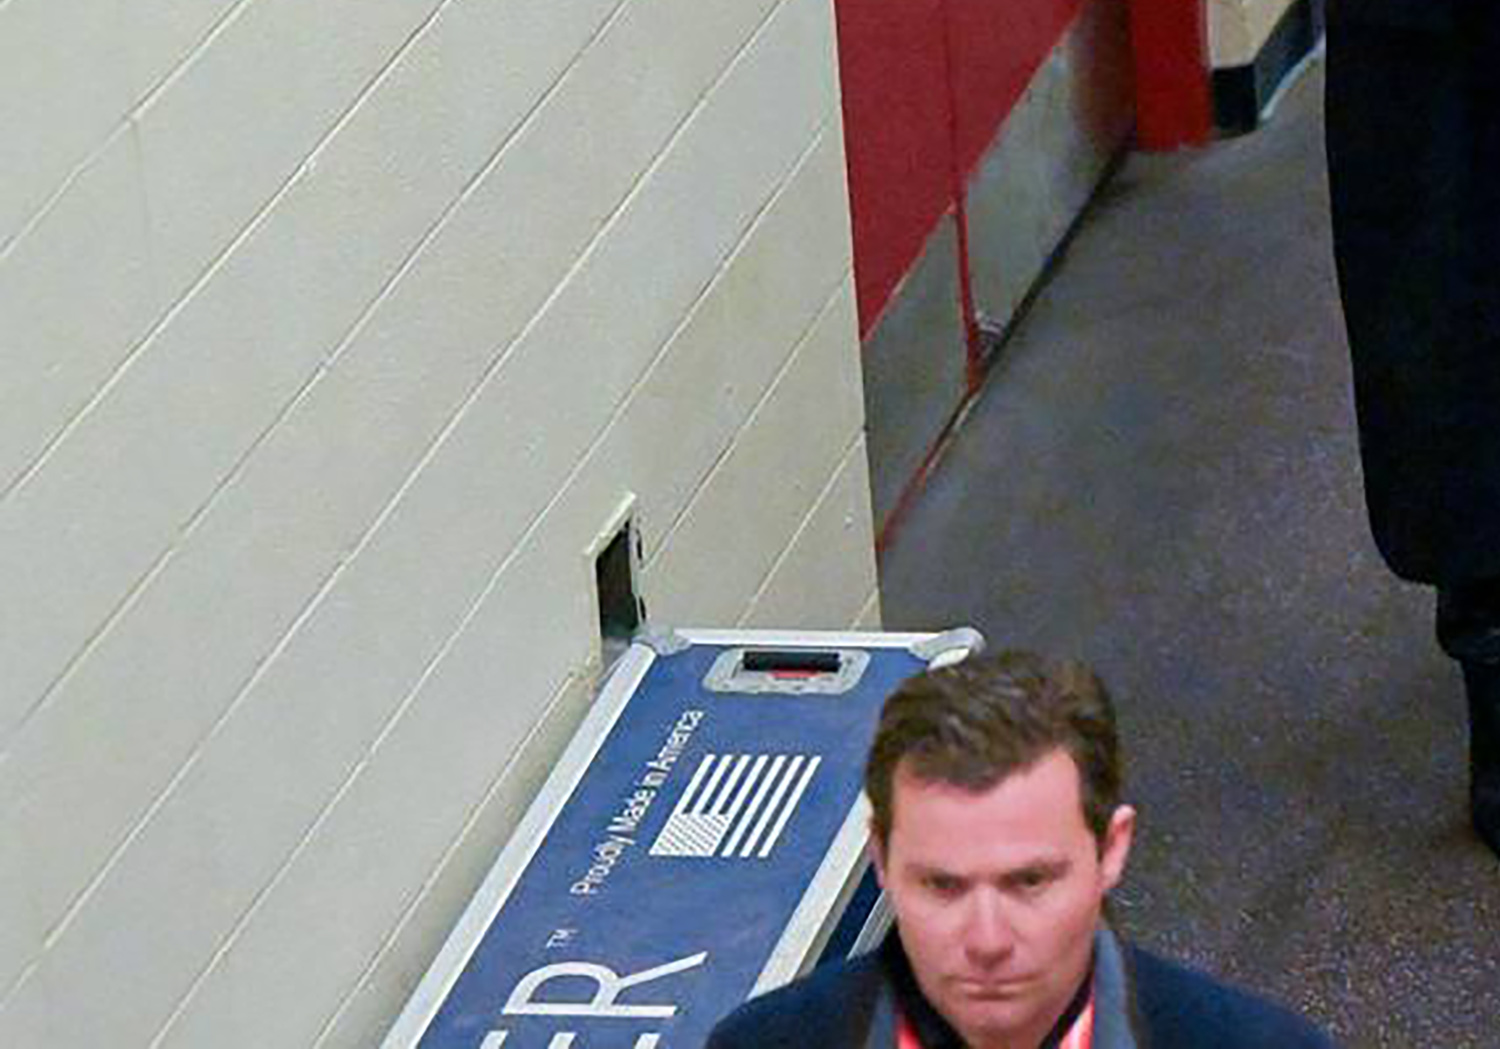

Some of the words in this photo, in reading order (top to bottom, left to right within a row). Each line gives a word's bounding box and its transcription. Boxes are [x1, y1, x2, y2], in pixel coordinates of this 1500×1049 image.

[570, 841, 624, 894] Proudly
[607, 790, 656, 845] Made
[647, 710, 705, 771] America
